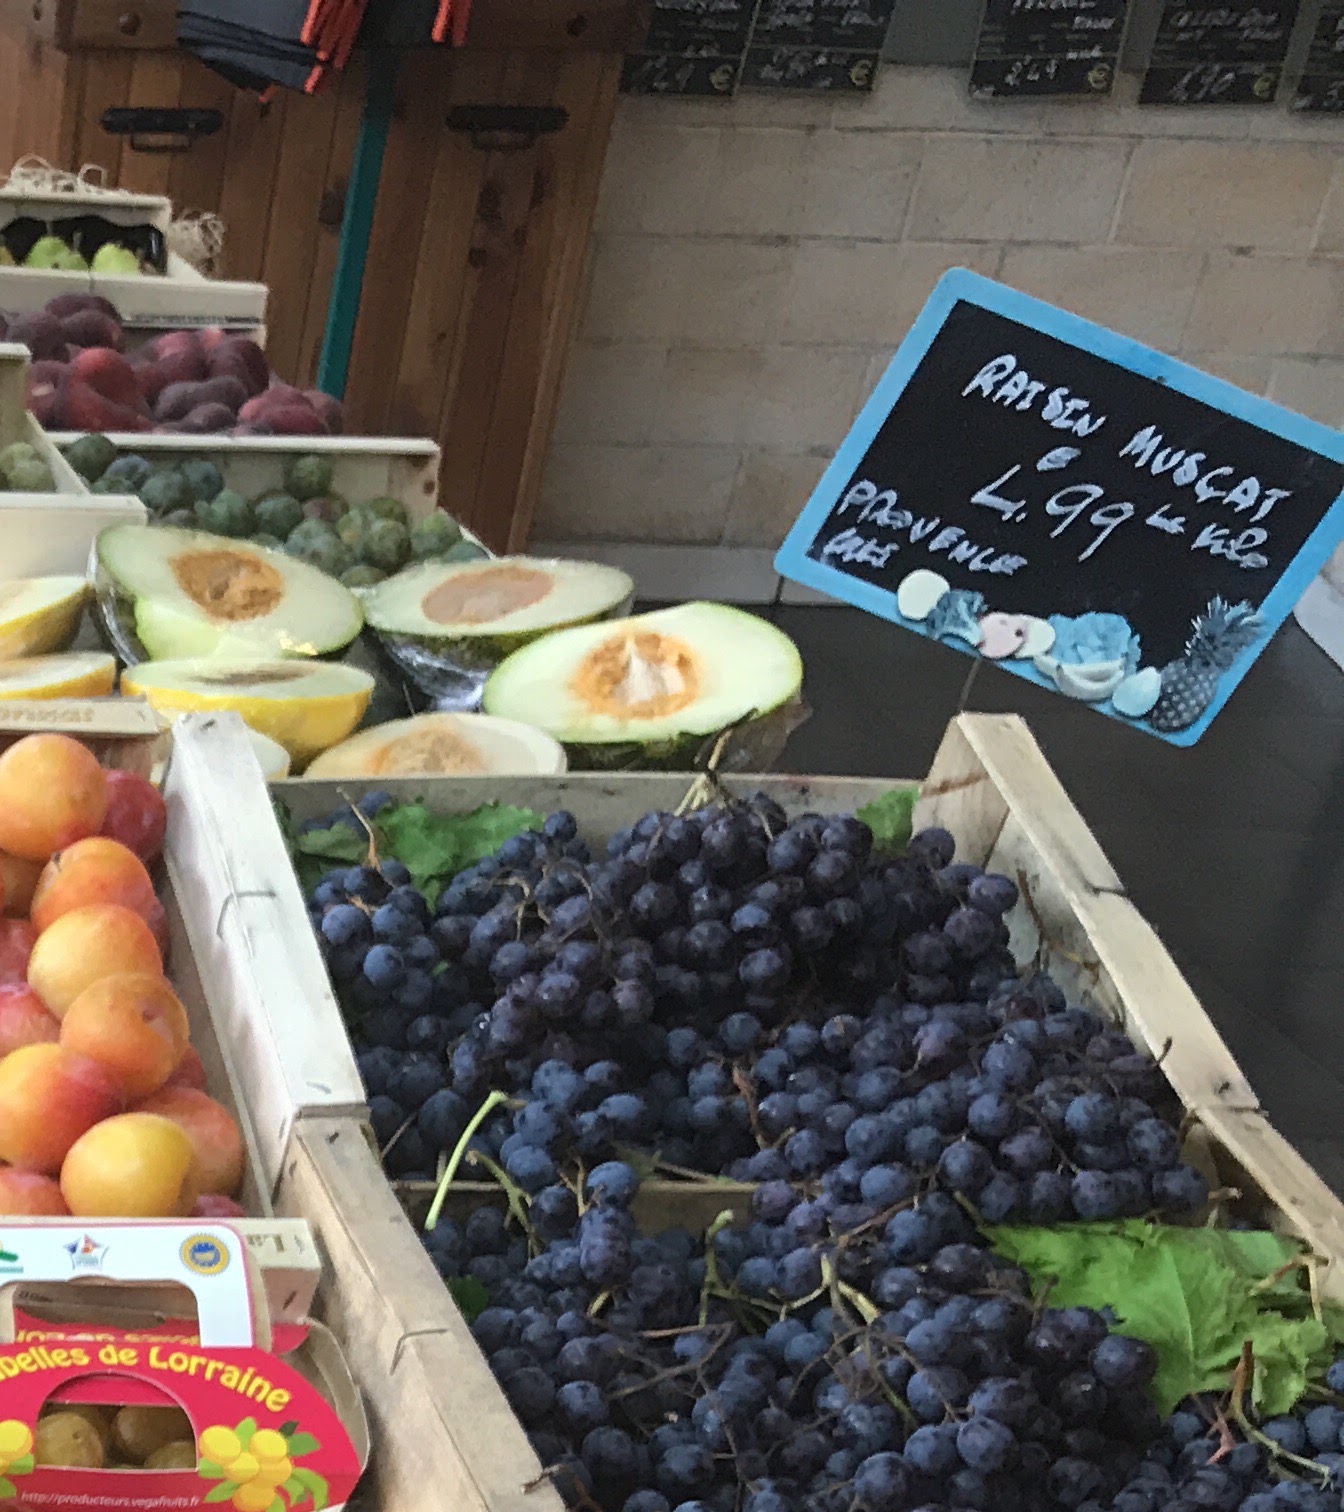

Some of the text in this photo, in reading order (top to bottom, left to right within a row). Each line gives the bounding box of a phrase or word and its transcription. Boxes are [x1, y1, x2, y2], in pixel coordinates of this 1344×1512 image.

[1120, 425, 1292, 522] MUSCAT
[99, 1345, 139, 1366] de
[149, 1346, 293, 1413] Lorraine
